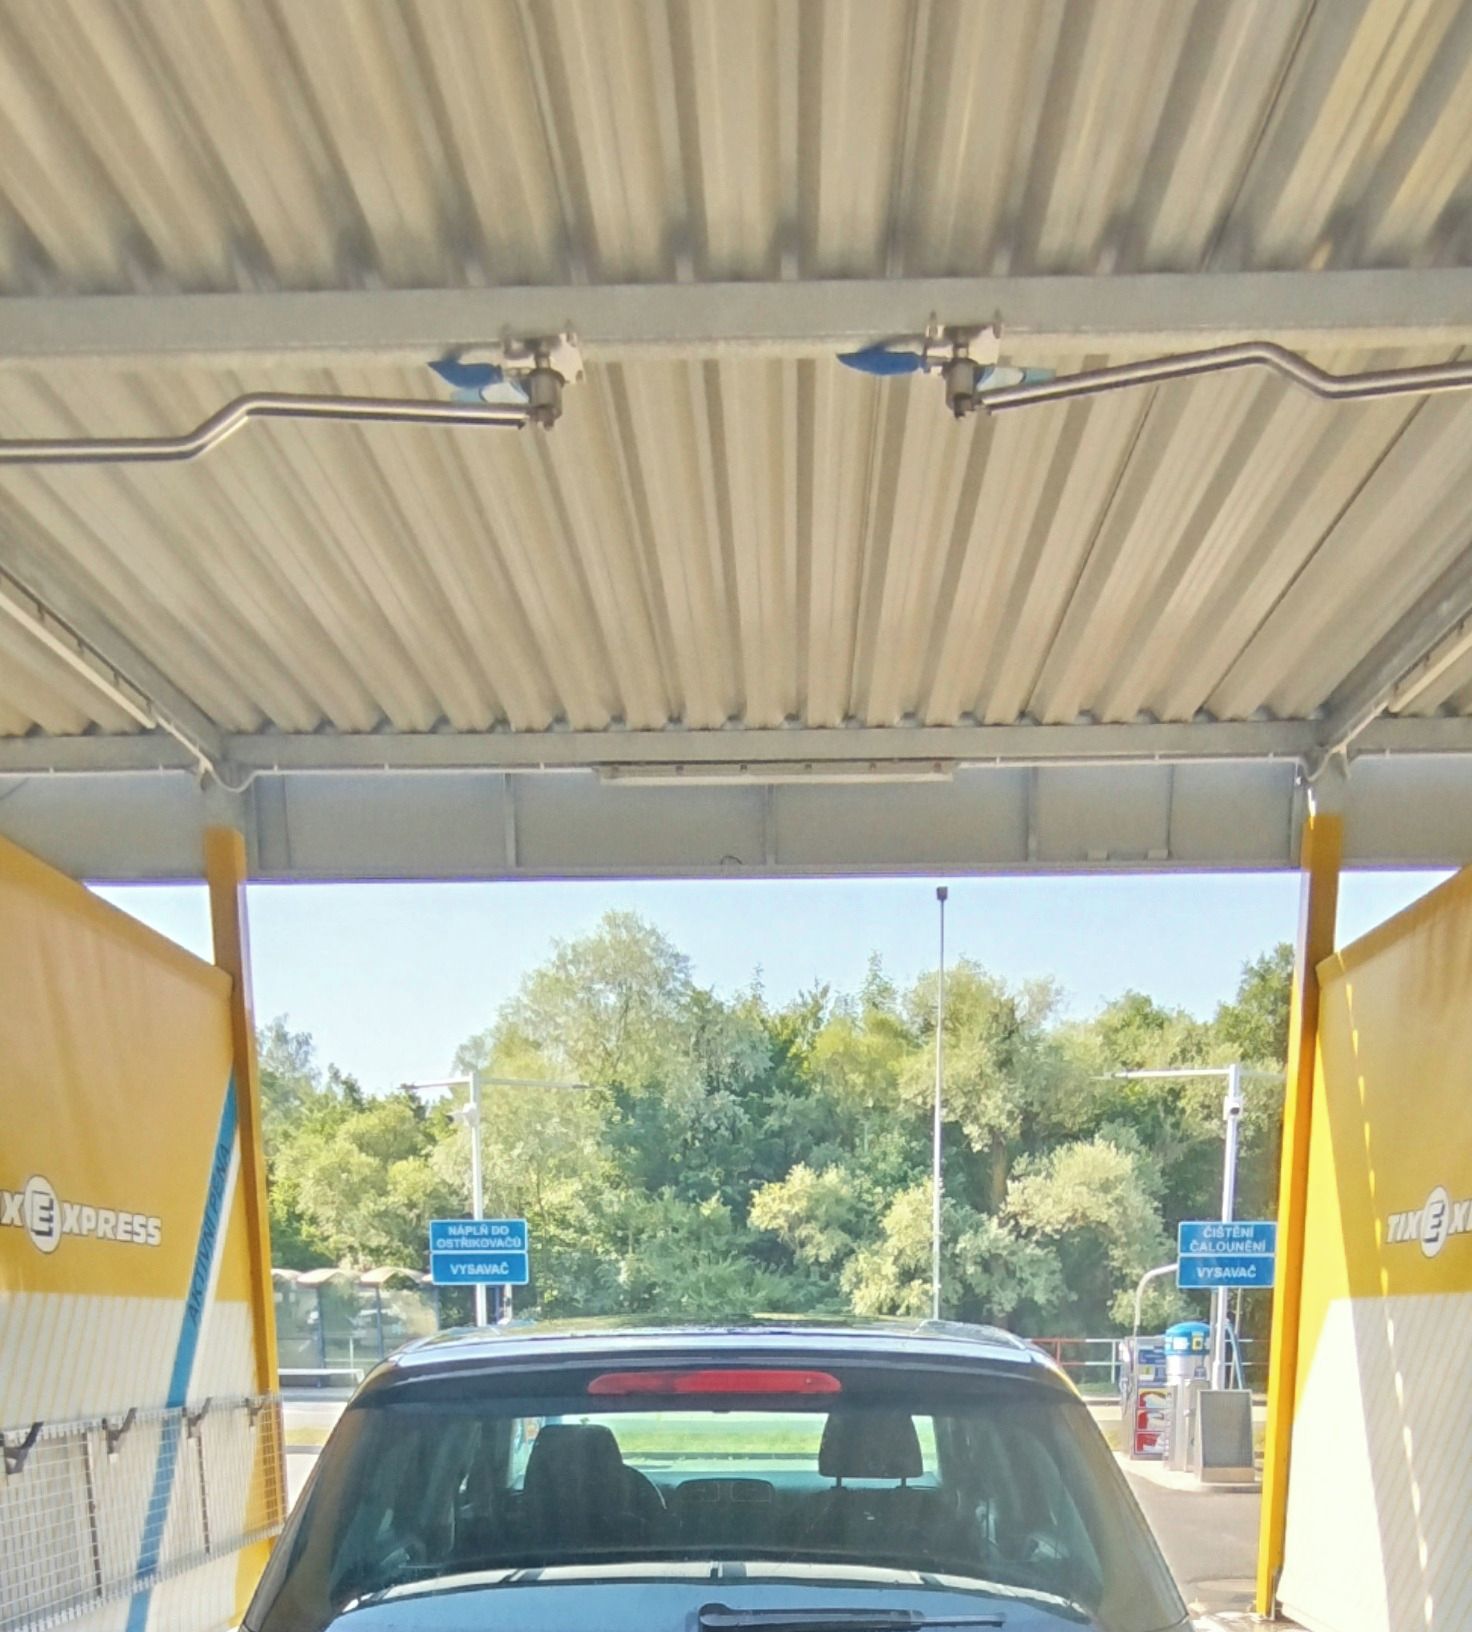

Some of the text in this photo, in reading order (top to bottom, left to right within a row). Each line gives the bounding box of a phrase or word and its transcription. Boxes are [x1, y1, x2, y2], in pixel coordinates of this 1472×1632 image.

[448, 1223, 510, 1236] NÁPLŇ DO
[1202, 1225, 1254, 1239] ČIŠTĚNÍ
[436, 1237, 522, 1249] OSTŘIKOVAČŮ
[1189, 1239, 1266, 1252] ČALOUNĚNÍ
[449, 1261, 510, 1275] VYSAVAČ
[1196, 1264, 1257, 1278] VYSAVAČ
